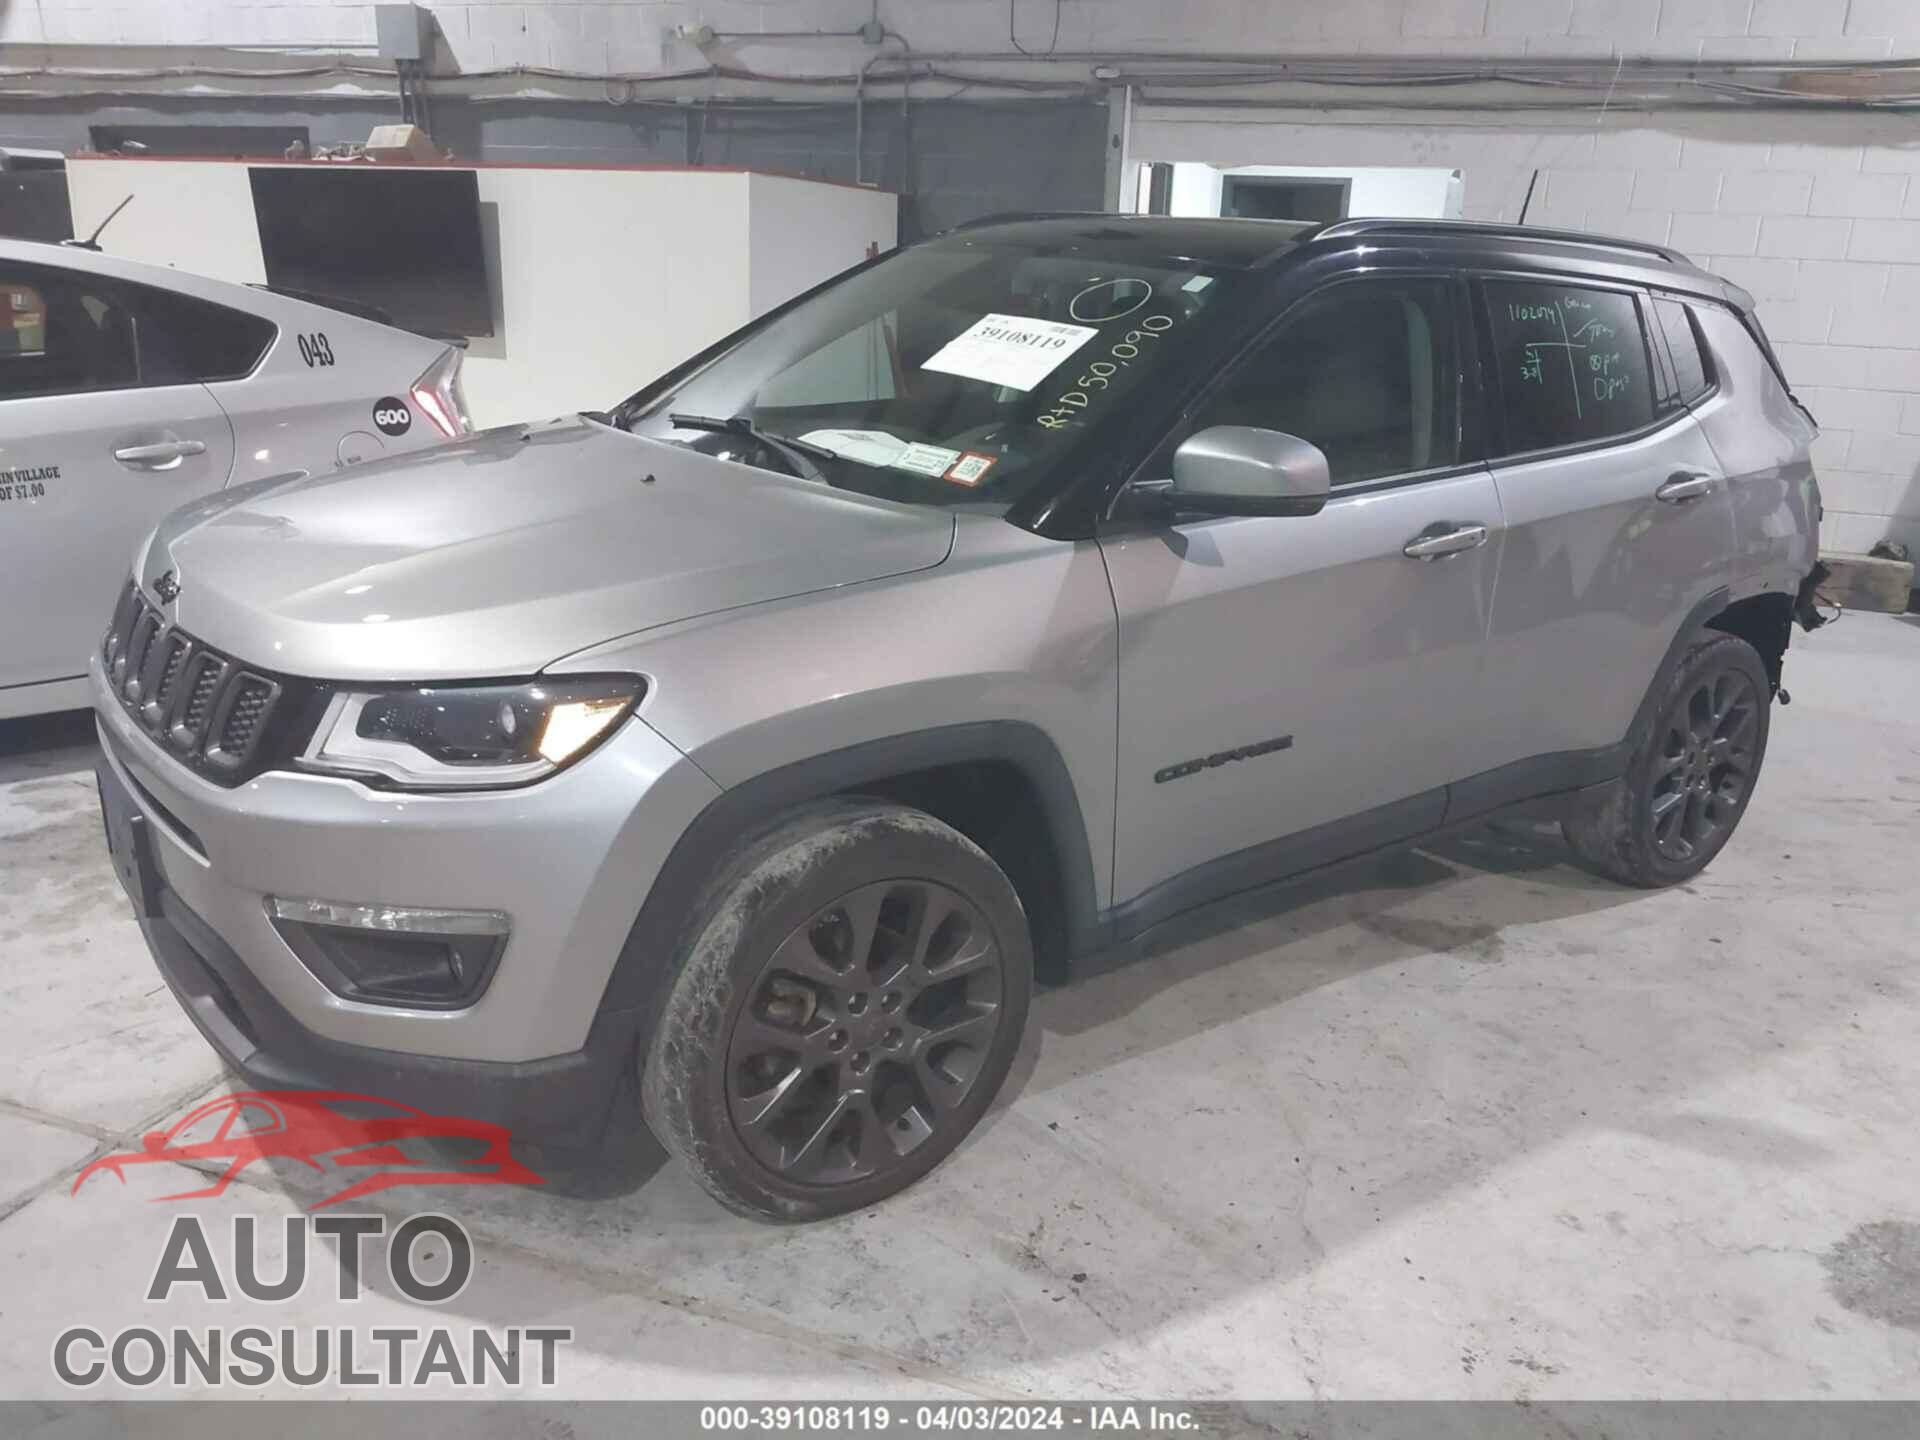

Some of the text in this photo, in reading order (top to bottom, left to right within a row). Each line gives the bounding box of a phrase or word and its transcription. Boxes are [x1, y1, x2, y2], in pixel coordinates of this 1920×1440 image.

[974, 326, 1067, 350] 39108119
[297, 332, 335, 368] 043
[375, 409, 409, 425] 600
[14, 466, 61, 483] VILLAGE
[15, 482, 45, 499] $7.00
